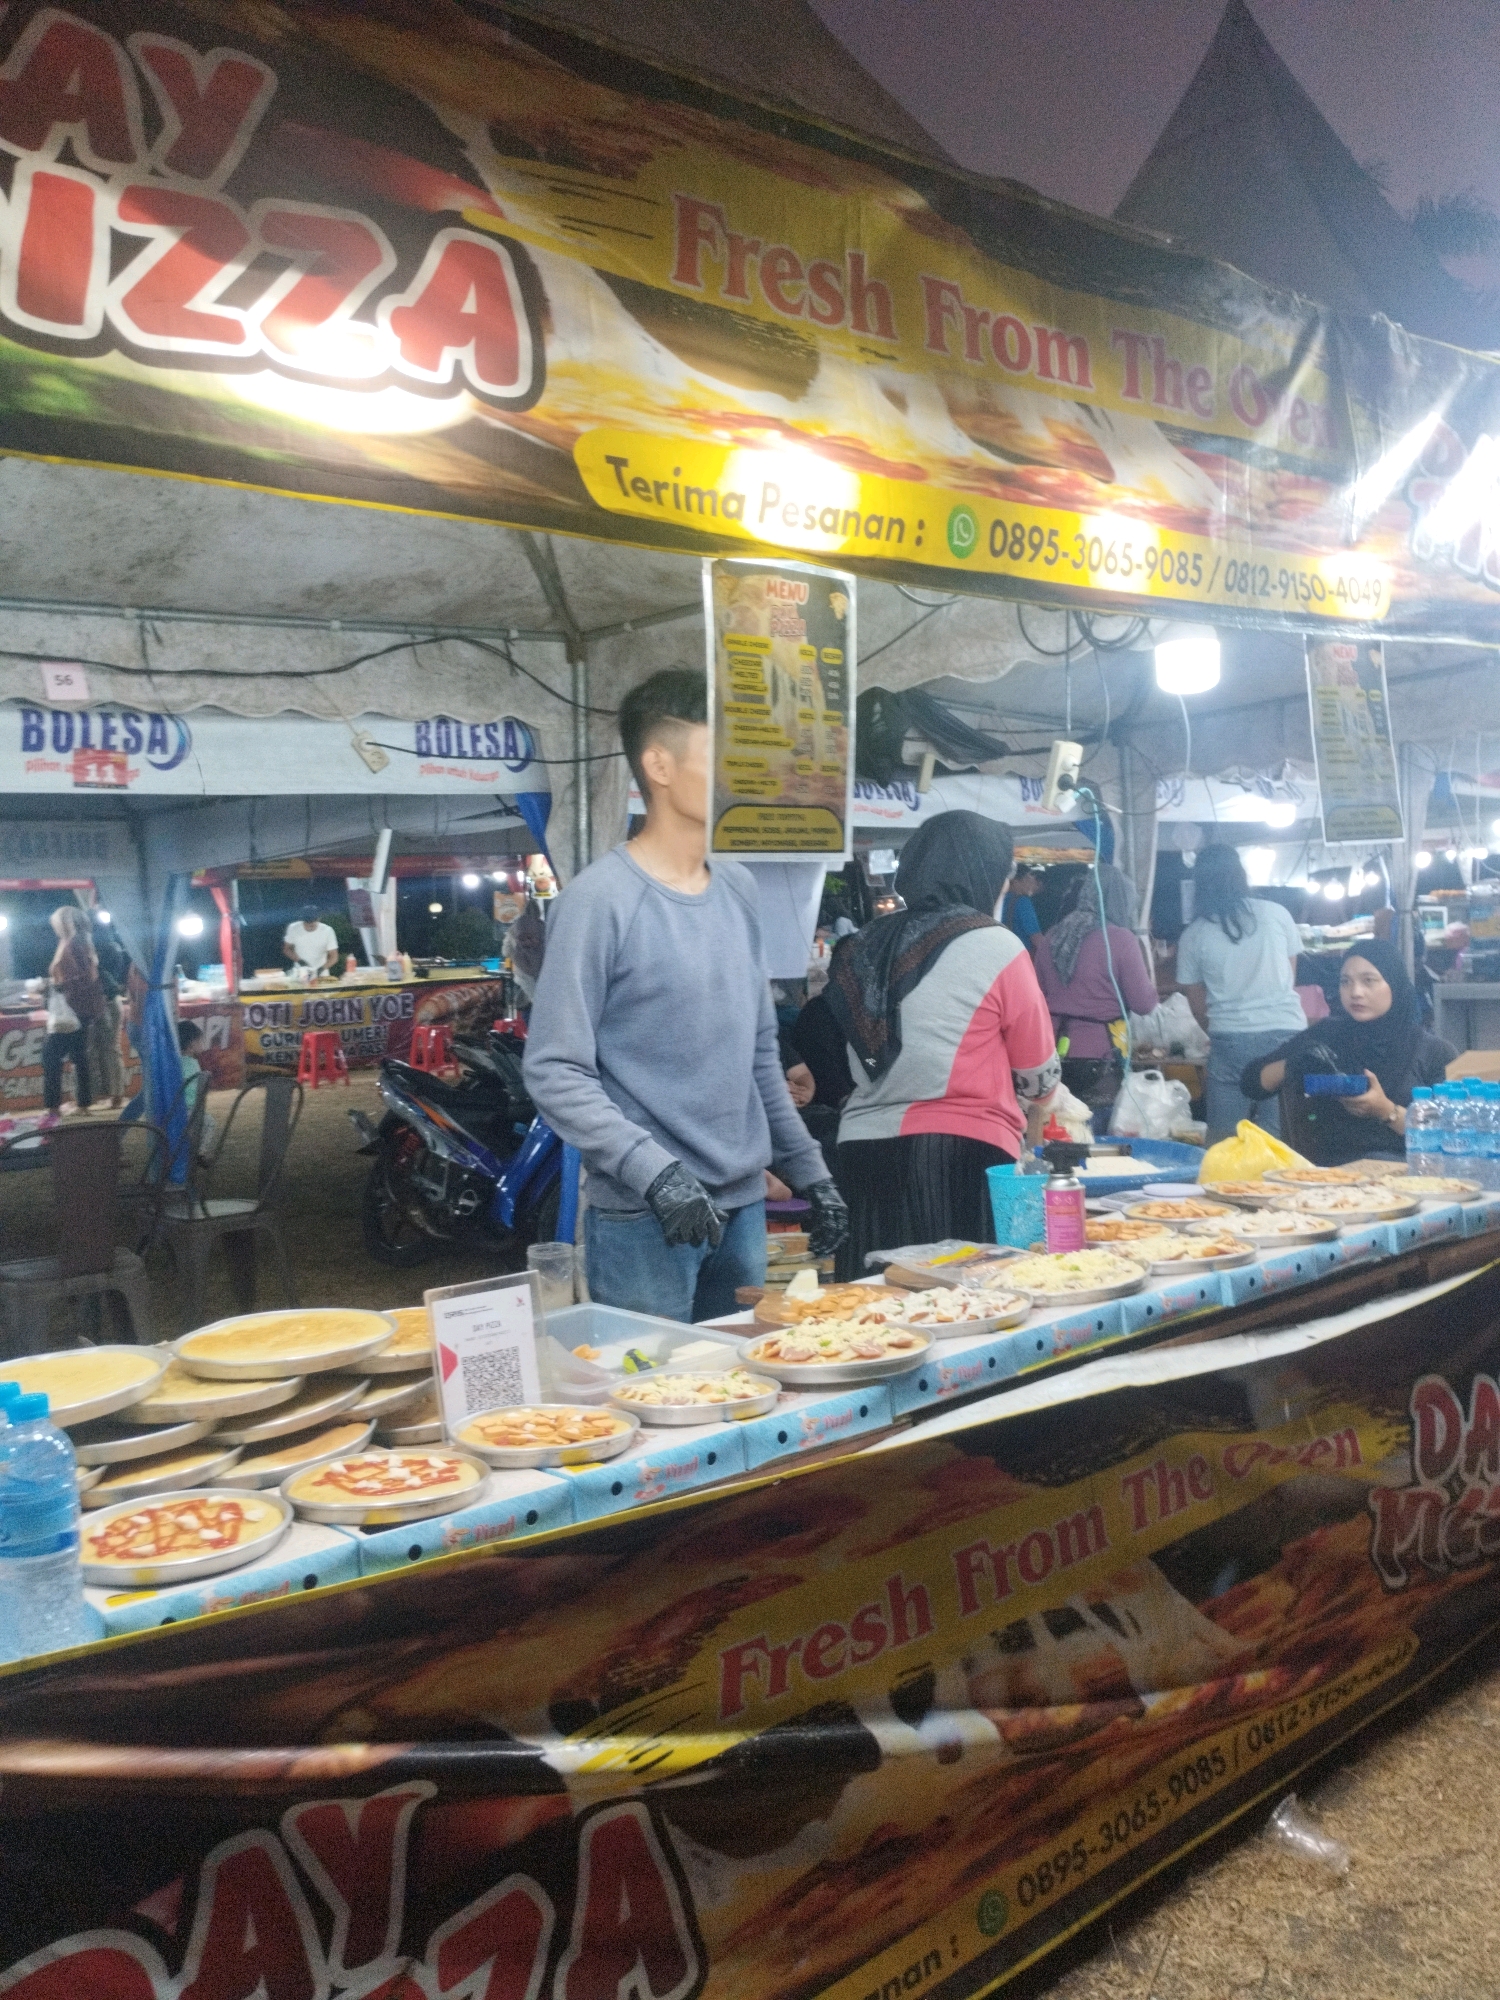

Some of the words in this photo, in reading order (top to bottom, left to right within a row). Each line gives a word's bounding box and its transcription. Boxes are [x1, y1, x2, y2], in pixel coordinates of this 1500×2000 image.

[671, 193, 898, 342] Fresh
[920, 274, 1094, 391] From
[1111, 328, 1216, 420] The
[1228, 363, 1339, 449] Oen
[606, 456, 746, 523] Terima
[758, 482, 906, 545] Pesanan
[987, 519, 1203, 588] 0895-3065-9085
[1224, 558, 1382, 607] 0812-9150-4049
[766, 579, 808, 603] MENU
[54, 674, 74, 686] 56
[22, 708, 169, 755] BOLESA
[416, 719, 520, 759] BOLESA
[85, 763, 118, 784] 11
[298, 997, 365, 1028] JOHN
[369, 993, 415, 1022] YOE
[1, 1011, 47, 1070] GE
[718, 1569, 936, 1721] Fresh
[952, 1503, 1112, 1618] From
[1121, 1451, 1217, 1536] The
[1016, 1746, 1227, 1908] 0895-3065-9085
